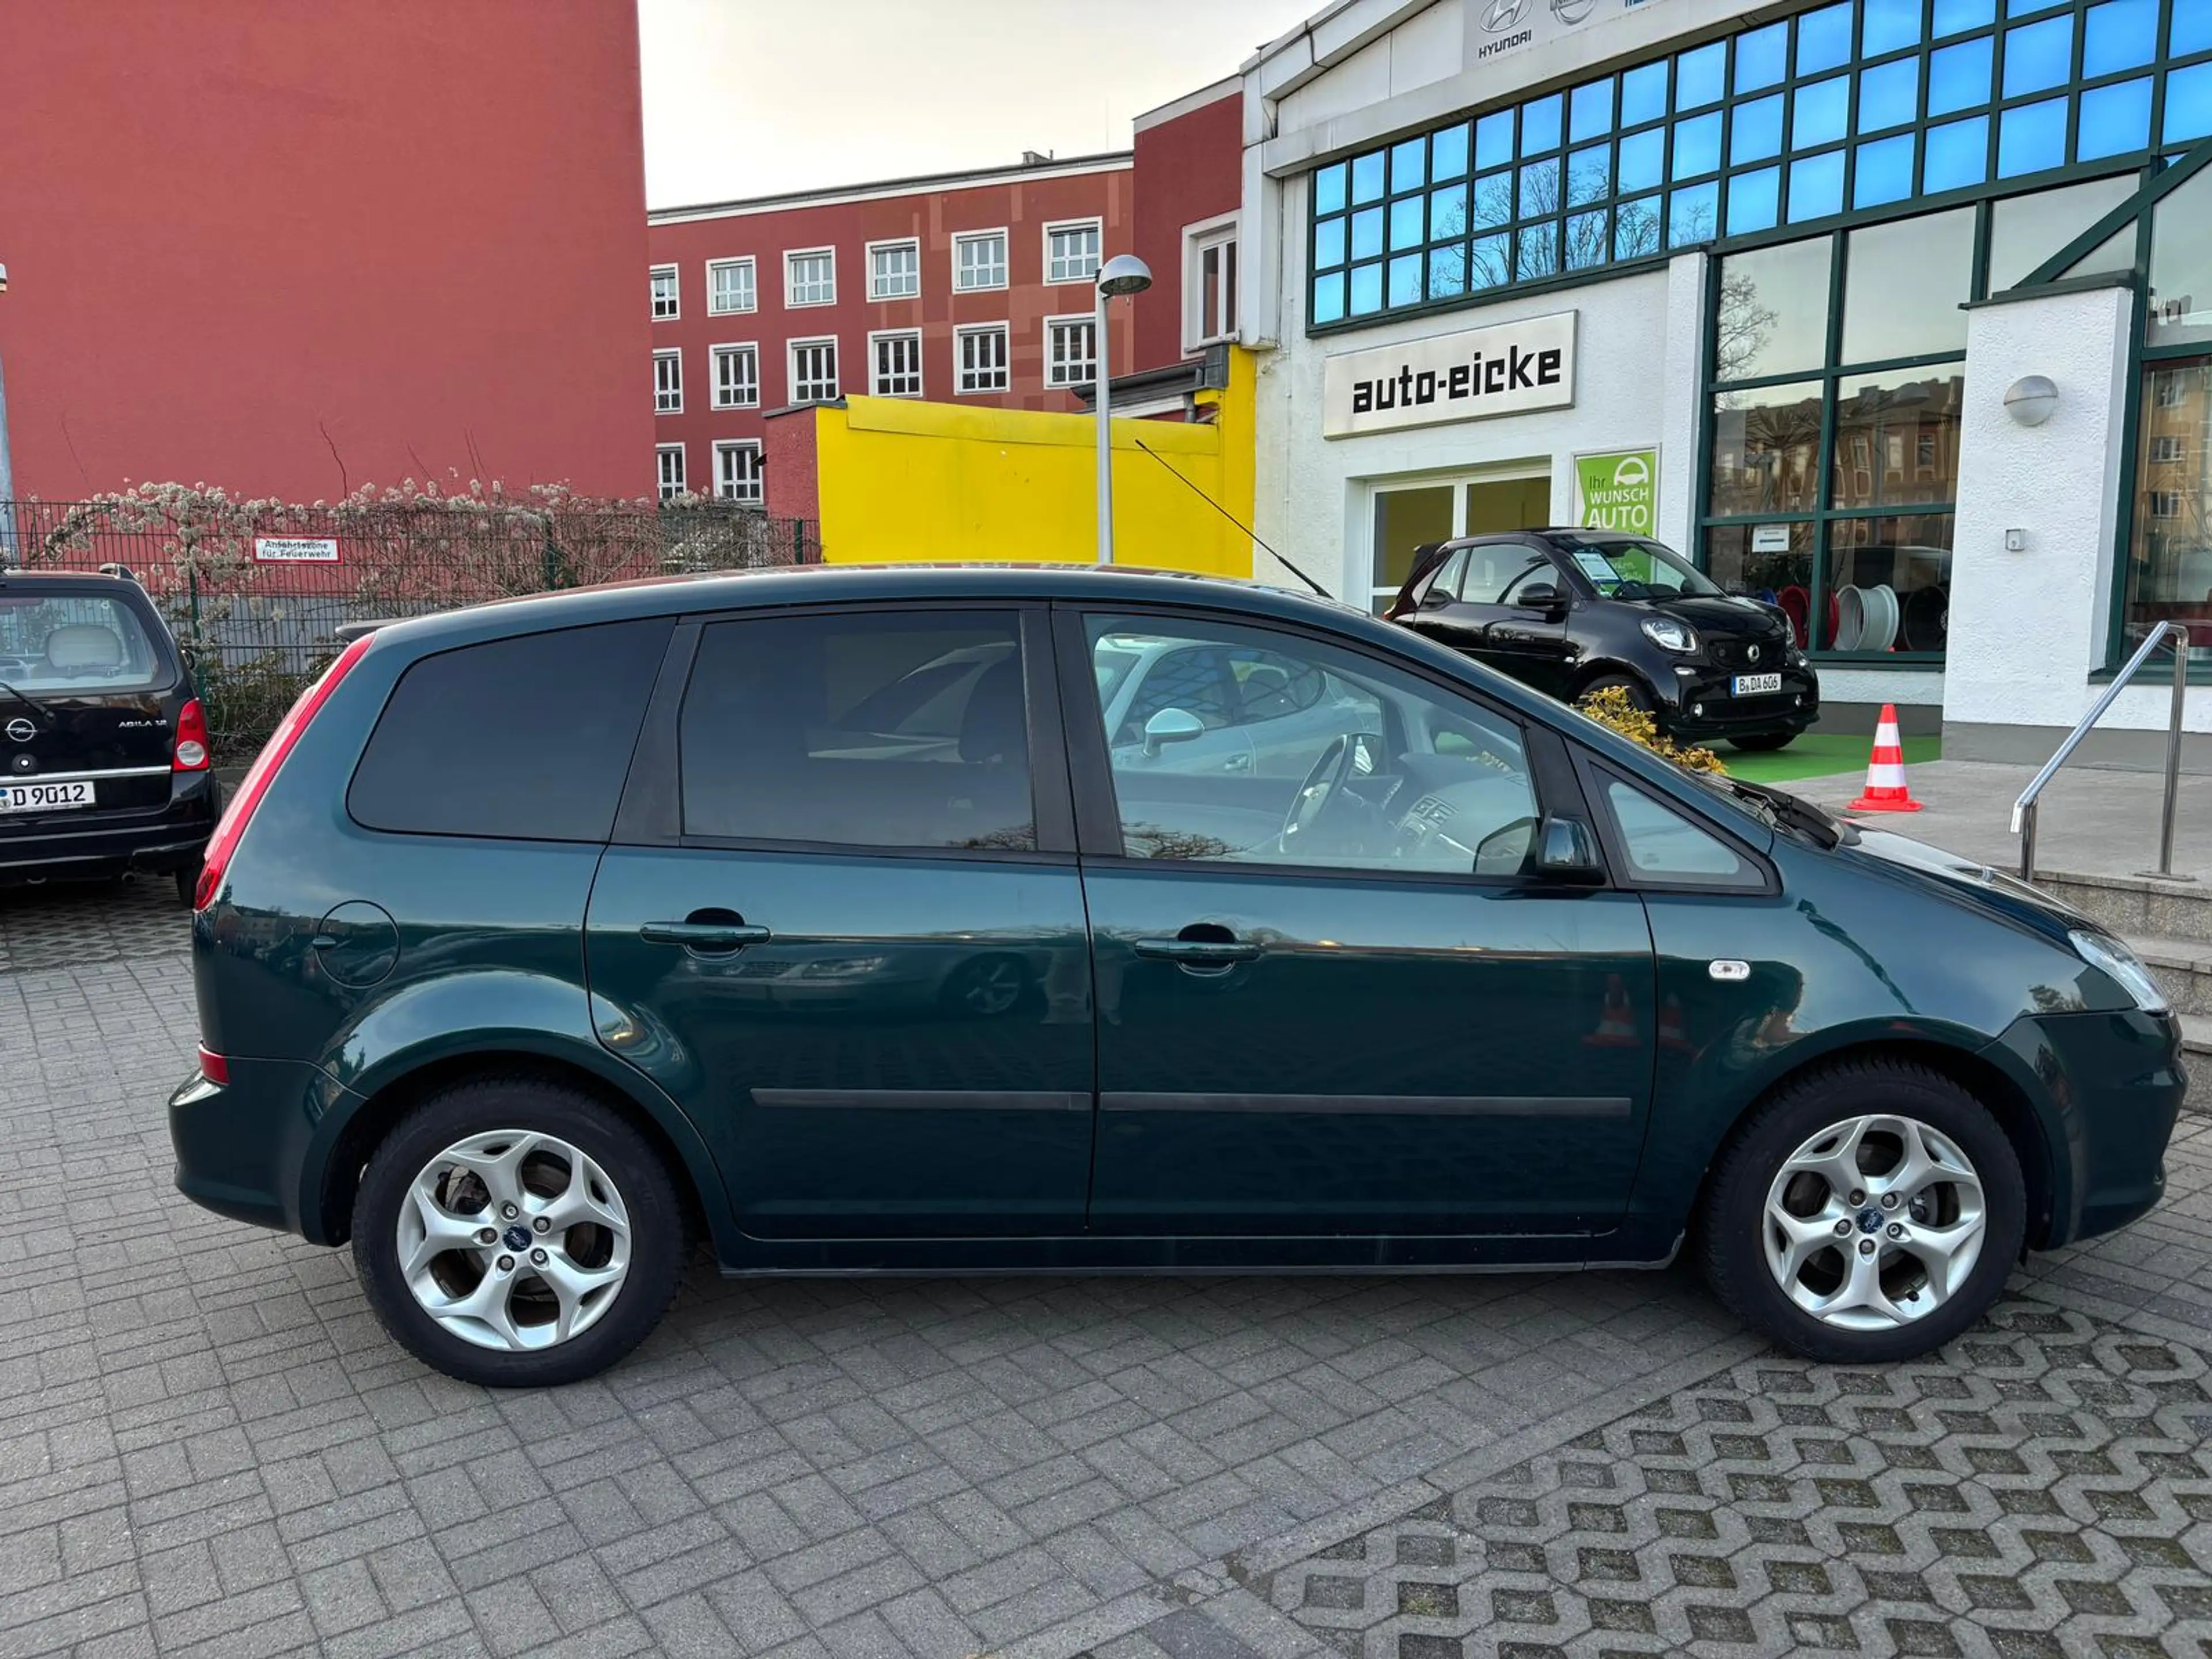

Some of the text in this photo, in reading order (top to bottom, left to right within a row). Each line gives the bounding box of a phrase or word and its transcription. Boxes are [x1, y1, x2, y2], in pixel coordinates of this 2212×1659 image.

[1479, 29, 1532, 59] HYUNDAI
[1353, 344, 1561, 414] auto-eicke
[1589, 475, 1606, 490] Ihr
[1590, 487, 1649, 505] WUNSCH
[1587, 504, 1647, 529] AUTO
[263, 549, 331, 558] für Feuerwehr
[119, 719, 153, 728] AGILA
[12, 785, 86, 806] D 9012
